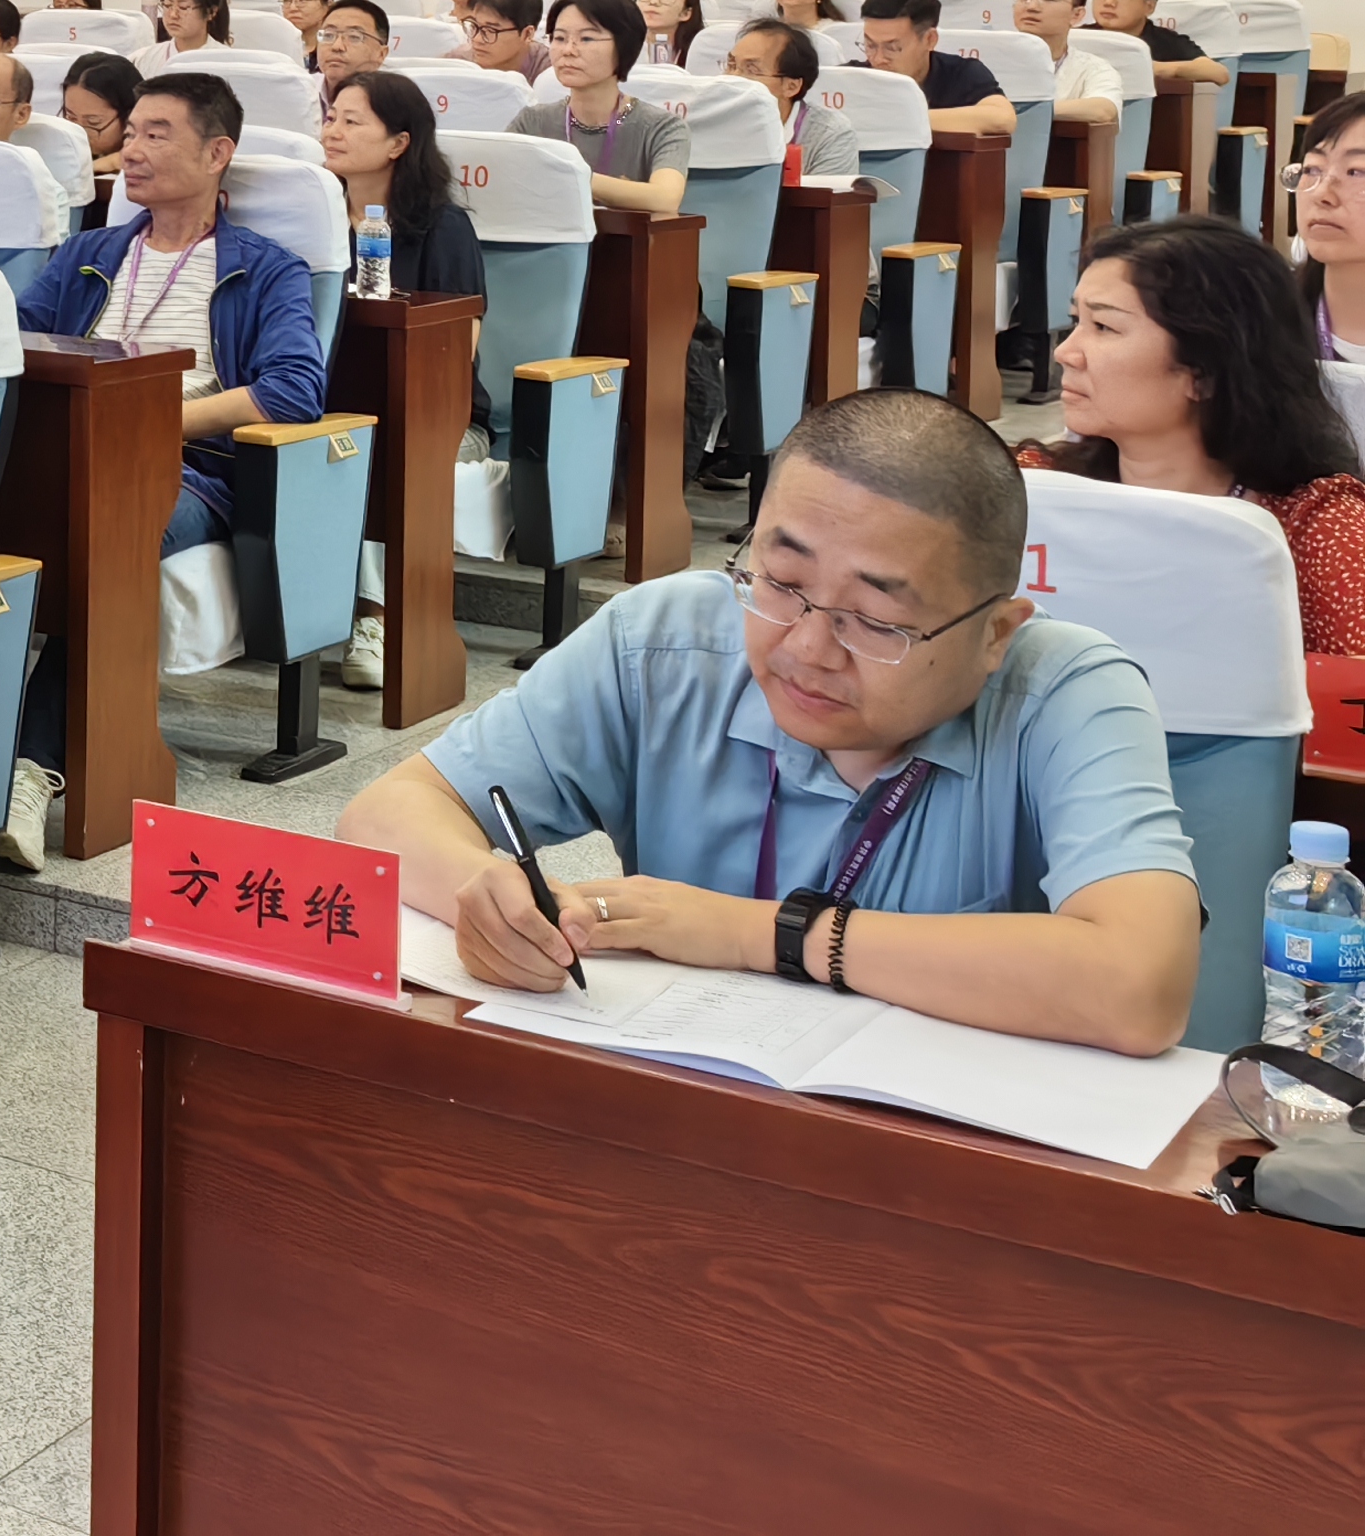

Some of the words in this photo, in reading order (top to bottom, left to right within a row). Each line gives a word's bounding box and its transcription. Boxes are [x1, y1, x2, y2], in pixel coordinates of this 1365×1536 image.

[982, 10, 991, 24] 9
[69, 27, 78, 42] 5
[392, 36, 401, 51] 7
[436, 94, 450, 114] 9
[821, 92, 845, 109] 10
[460, 165, 489, 188] 10
[168, 851, 360, 945] 方维维
